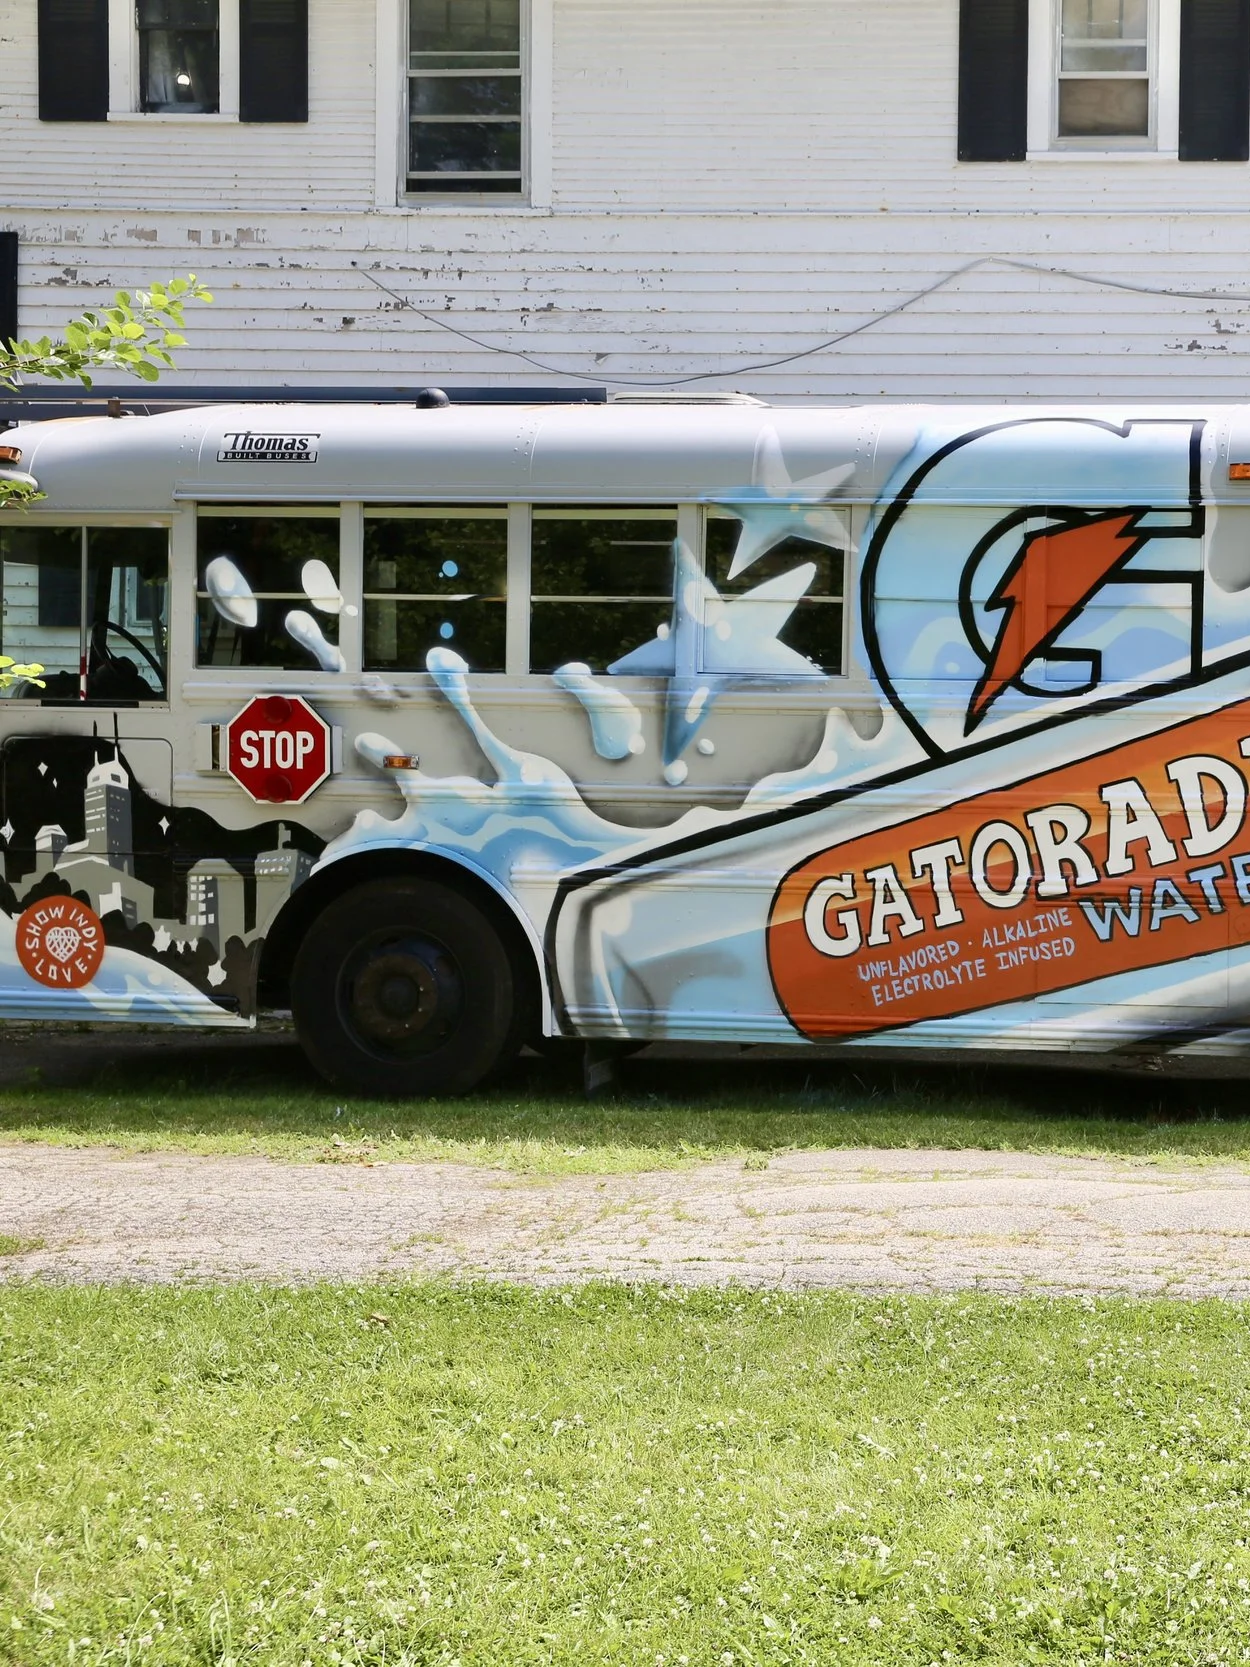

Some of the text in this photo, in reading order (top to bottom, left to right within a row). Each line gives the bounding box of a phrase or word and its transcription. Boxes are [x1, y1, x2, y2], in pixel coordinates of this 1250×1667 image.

[224, 431, 316, 451] Thomas
[226, 452, 307, 460] BUILT BUSES
[240, 730, 315, 769] STOP
[25, 905, 98, 952] SHOW INDY
[857, 907, 1073, 982] UNFLAVORED ALKALINE
[35, 957, 88, 983] LOVE
[871, 936, 1076, 1007] ELECTROLYTE INFUSED
